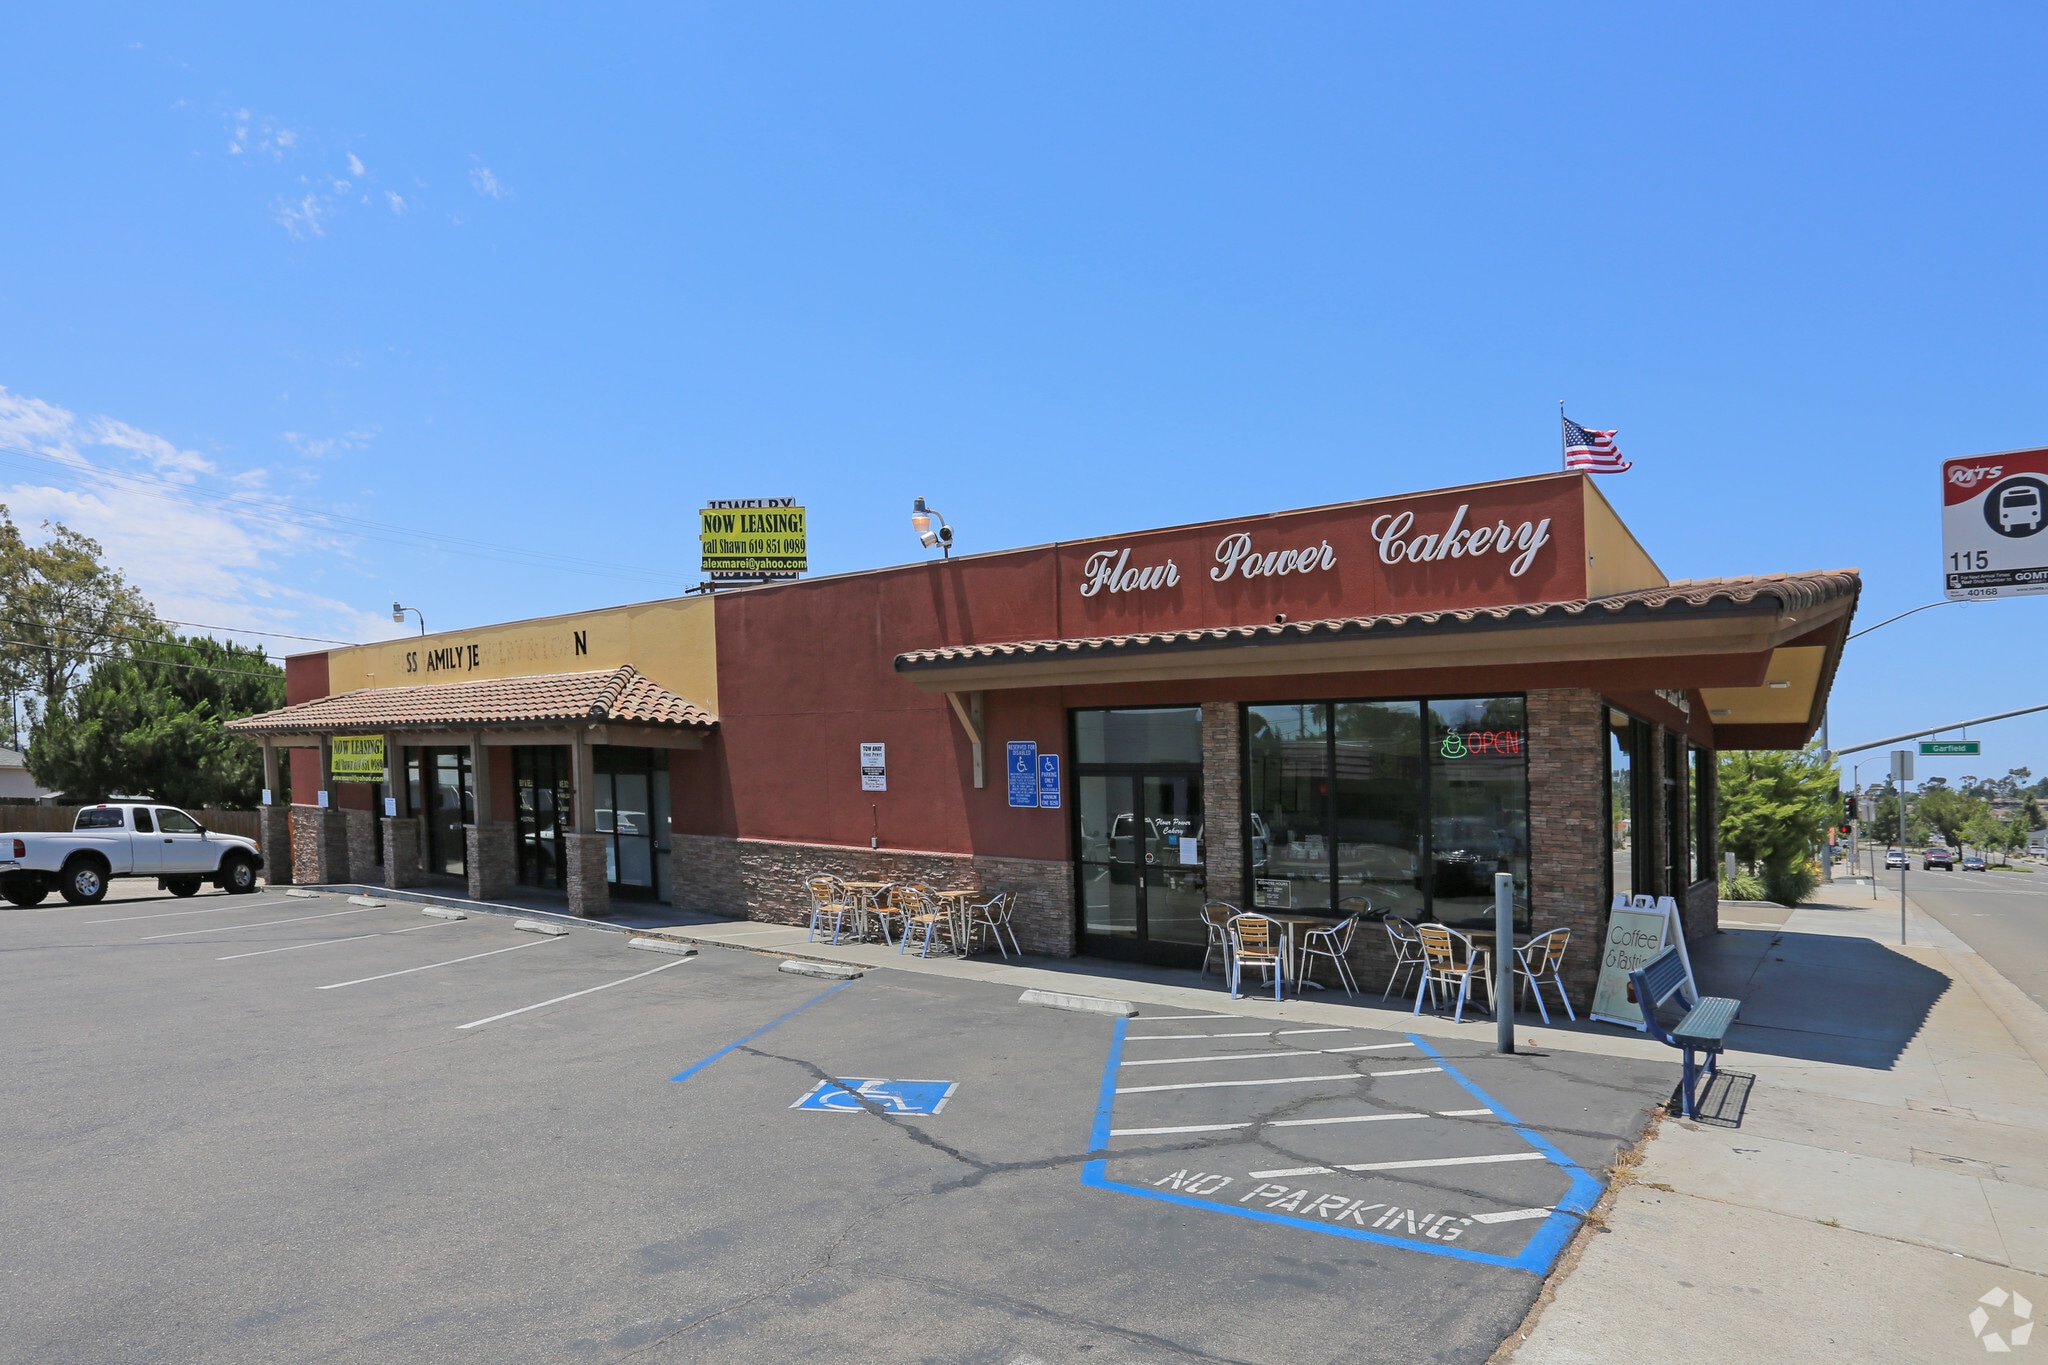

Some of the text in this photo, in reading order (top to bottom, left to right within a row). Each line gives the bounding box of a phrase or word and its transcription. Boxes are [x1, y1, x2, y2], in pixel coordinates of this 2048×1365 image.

[1949, 465, 2004, 483] MTS
[704, 513, 803, 533] NOW LEASING!
[703, 538, 806, 553] call Shawn 619 851 0989
[1080, 504, 1552, 597] Flour Power Cakery
[702, 558, 807, 571] alexmarei@yahoo.com
[1950, 551, 1989, 571] 115
[1967, 588, 1998, 596] 40168
[1467, 731, 1519, 754] OPEN
[1155, 818, 1191, 826] Flour Power
[1163, 826, 1183, 835] Cakery
[1611, 926, 1658, 949] Coffee
[1606, 949, 1616, 967] &
[1153, 1169, 1475, 1241] NO PARKING
